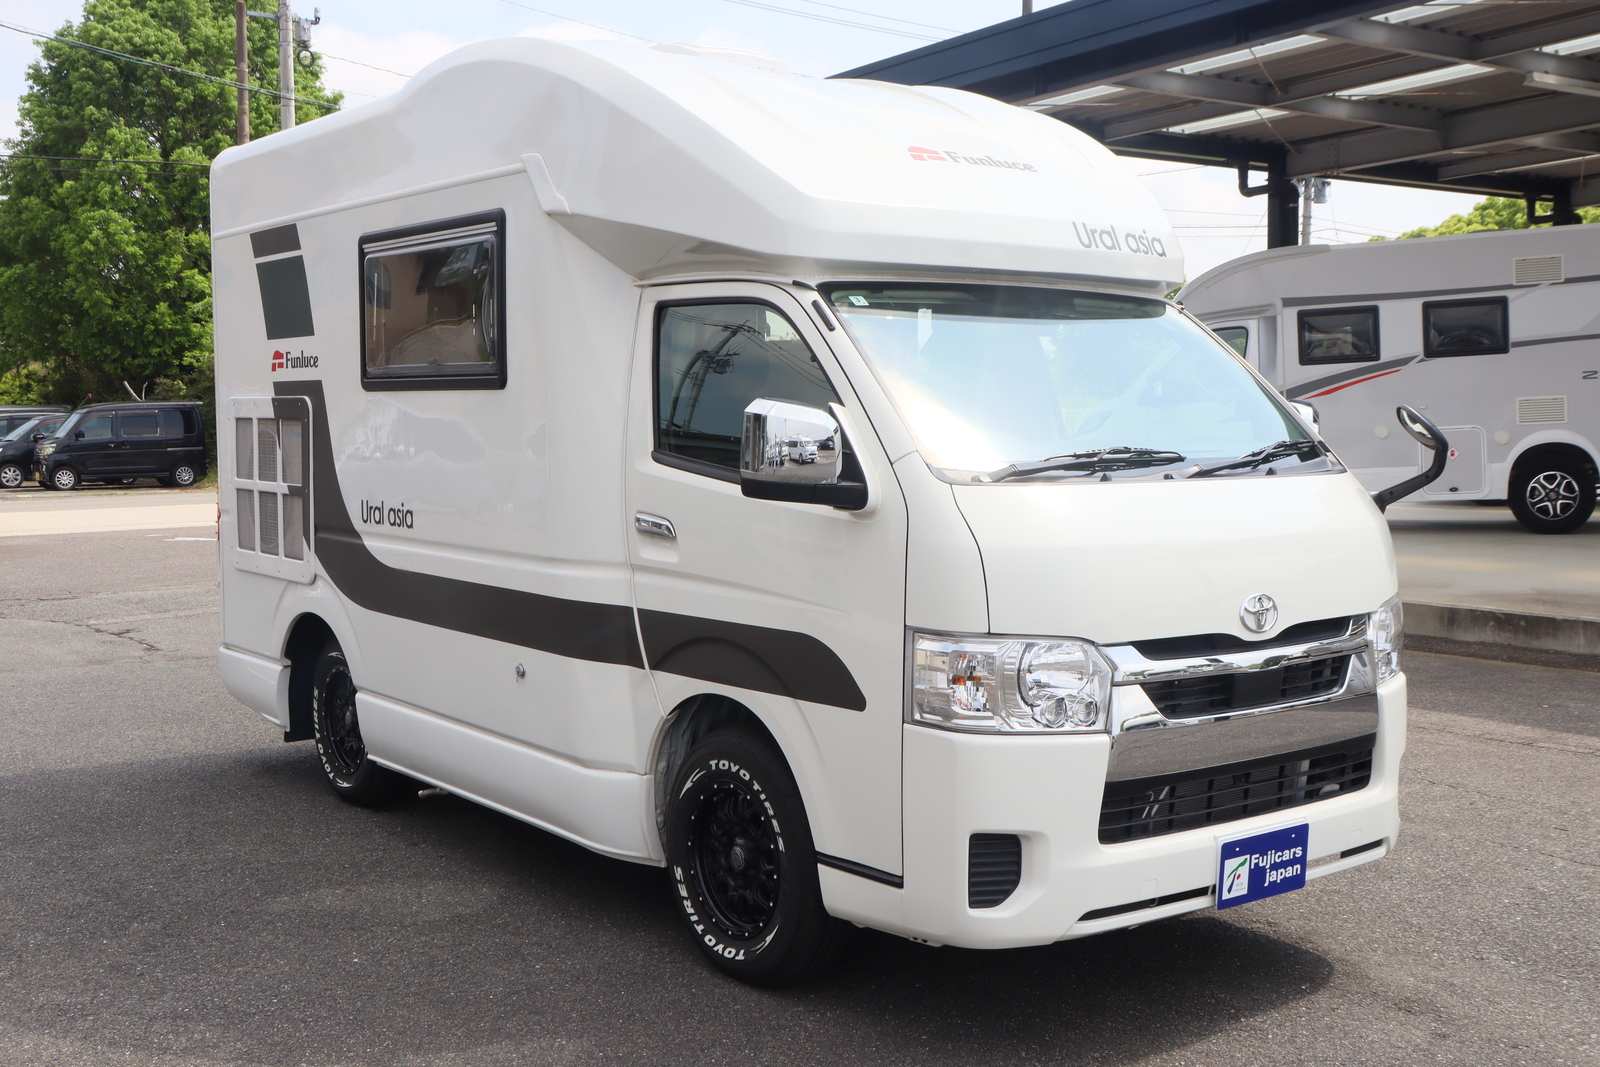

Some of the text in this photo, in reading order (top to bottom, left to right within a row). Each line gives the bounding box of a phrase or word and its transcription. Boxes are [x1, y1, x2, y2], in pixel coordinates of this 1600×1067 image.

[942, 150, 1037, 173] Funluce
[1072, 221, 1167, 258] Ural asia
[285, 350, 319, 369] Funluce
[360, 499, 414, 529] Ural asia
[313, 686, 335, 780] TOYO TIRES
[709, 759, 786, 853] TOYO TIRES
[1250, 846, 1303, 869] Fujicars
[1264, 864, 1301, 886] japan
[673, 865, 746, 961] TOYO TIRES
